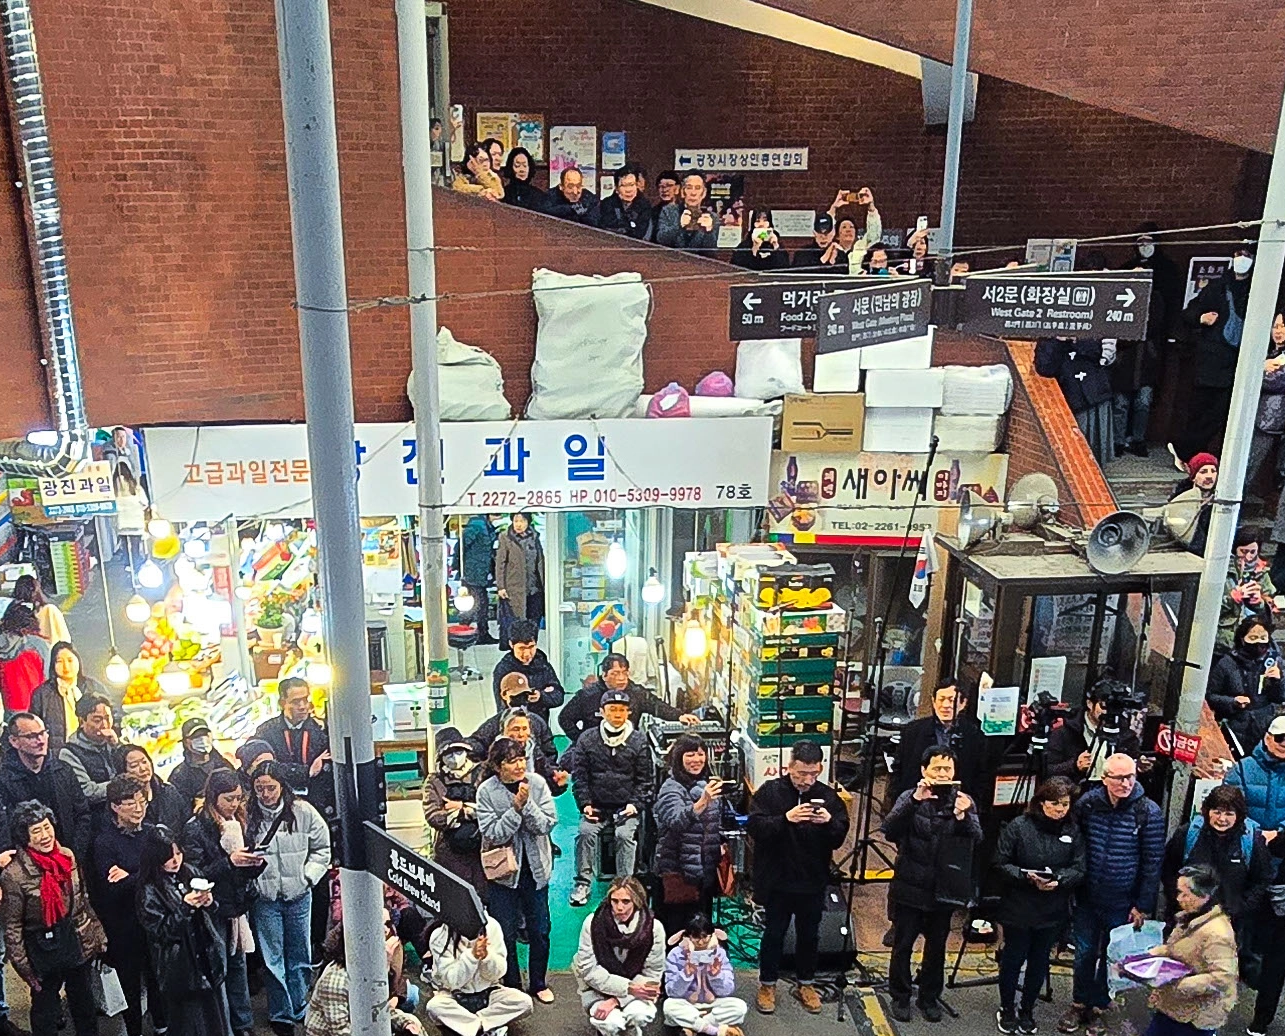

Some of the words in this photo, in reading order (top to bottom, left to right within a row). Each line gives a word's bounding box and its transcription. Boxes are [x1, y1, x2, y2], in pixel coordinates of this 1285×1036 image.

[780, 313, 803, 322] Food
[805, 314, 817, 322] Zo
[991, 308, 1012, 318] West
[1014, 308, 1034, 318] Gate
[1036, 308, 1042, 318] 2
[32, 475, 112, 497] 광진과일
[842, 468, 927, 501] 새아씨
[467, 489, 562, 508] T.2272-2865
[569, 485, 702, 505] HP.010-5309-9978
[715, 483, 753, 501] 78호
[1176, 735, 1198, 753] 금연
